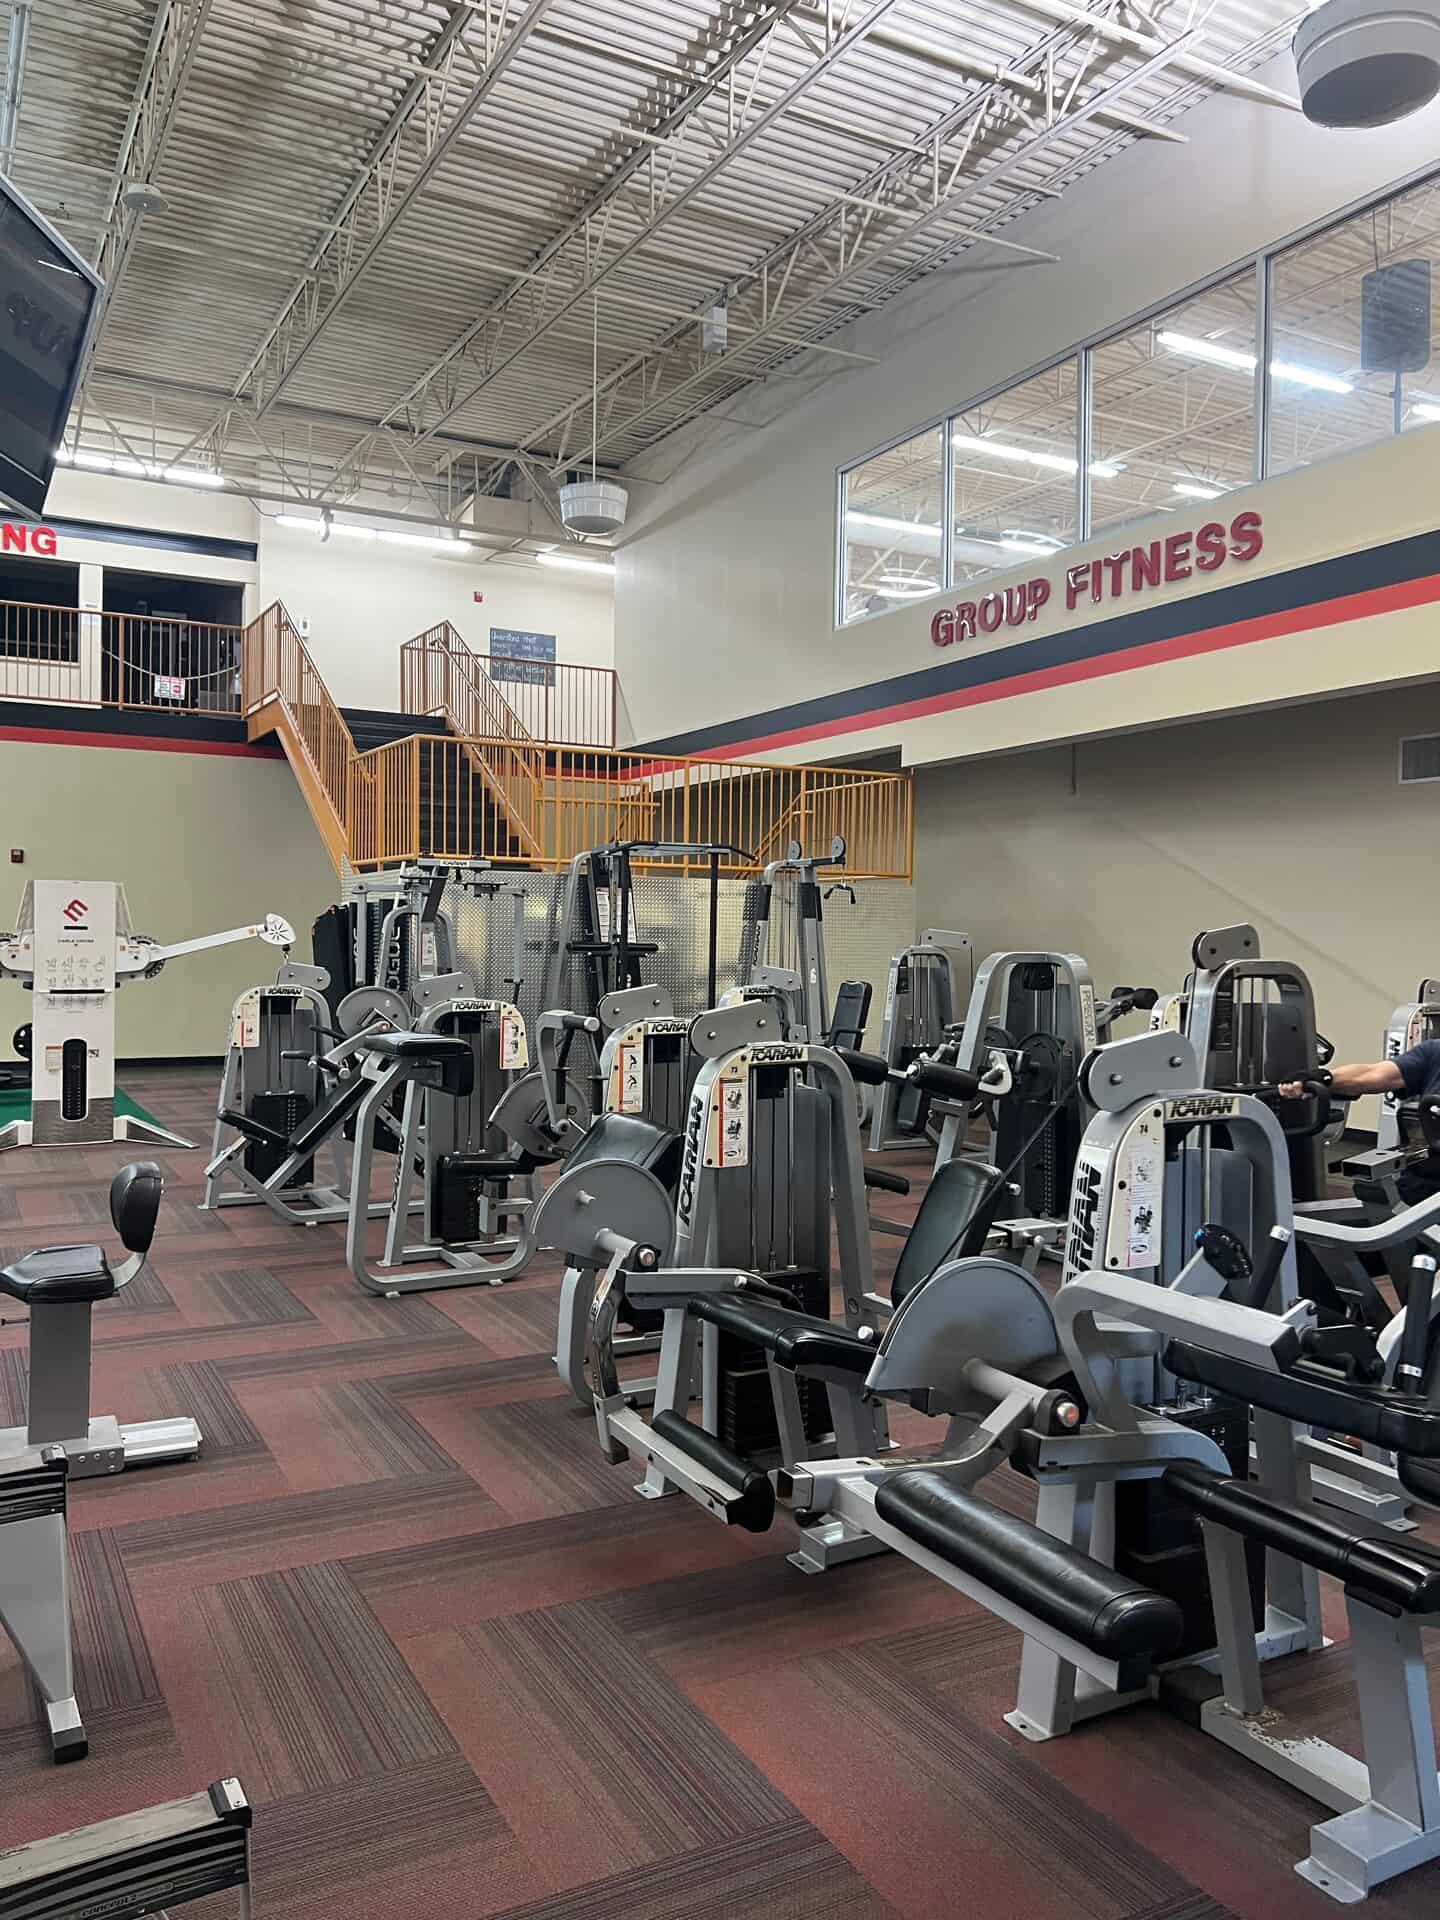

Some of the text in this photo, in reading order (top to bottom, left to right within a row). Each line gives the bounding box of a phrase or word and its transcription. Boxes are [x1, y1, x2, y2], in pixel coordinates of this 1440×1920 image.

[931, 511, 1264, 647] GROUP FITNESS
[455, 1001, 492, 1010] ICARIAN
[751, 1045, 803, 1062] ICARIAN
[1170, 1096, 1234, 1118] ICARIAN
[1139, 1124, 1149, 1134] 74
[679, 1095, 704, 1227] ICARIAN
